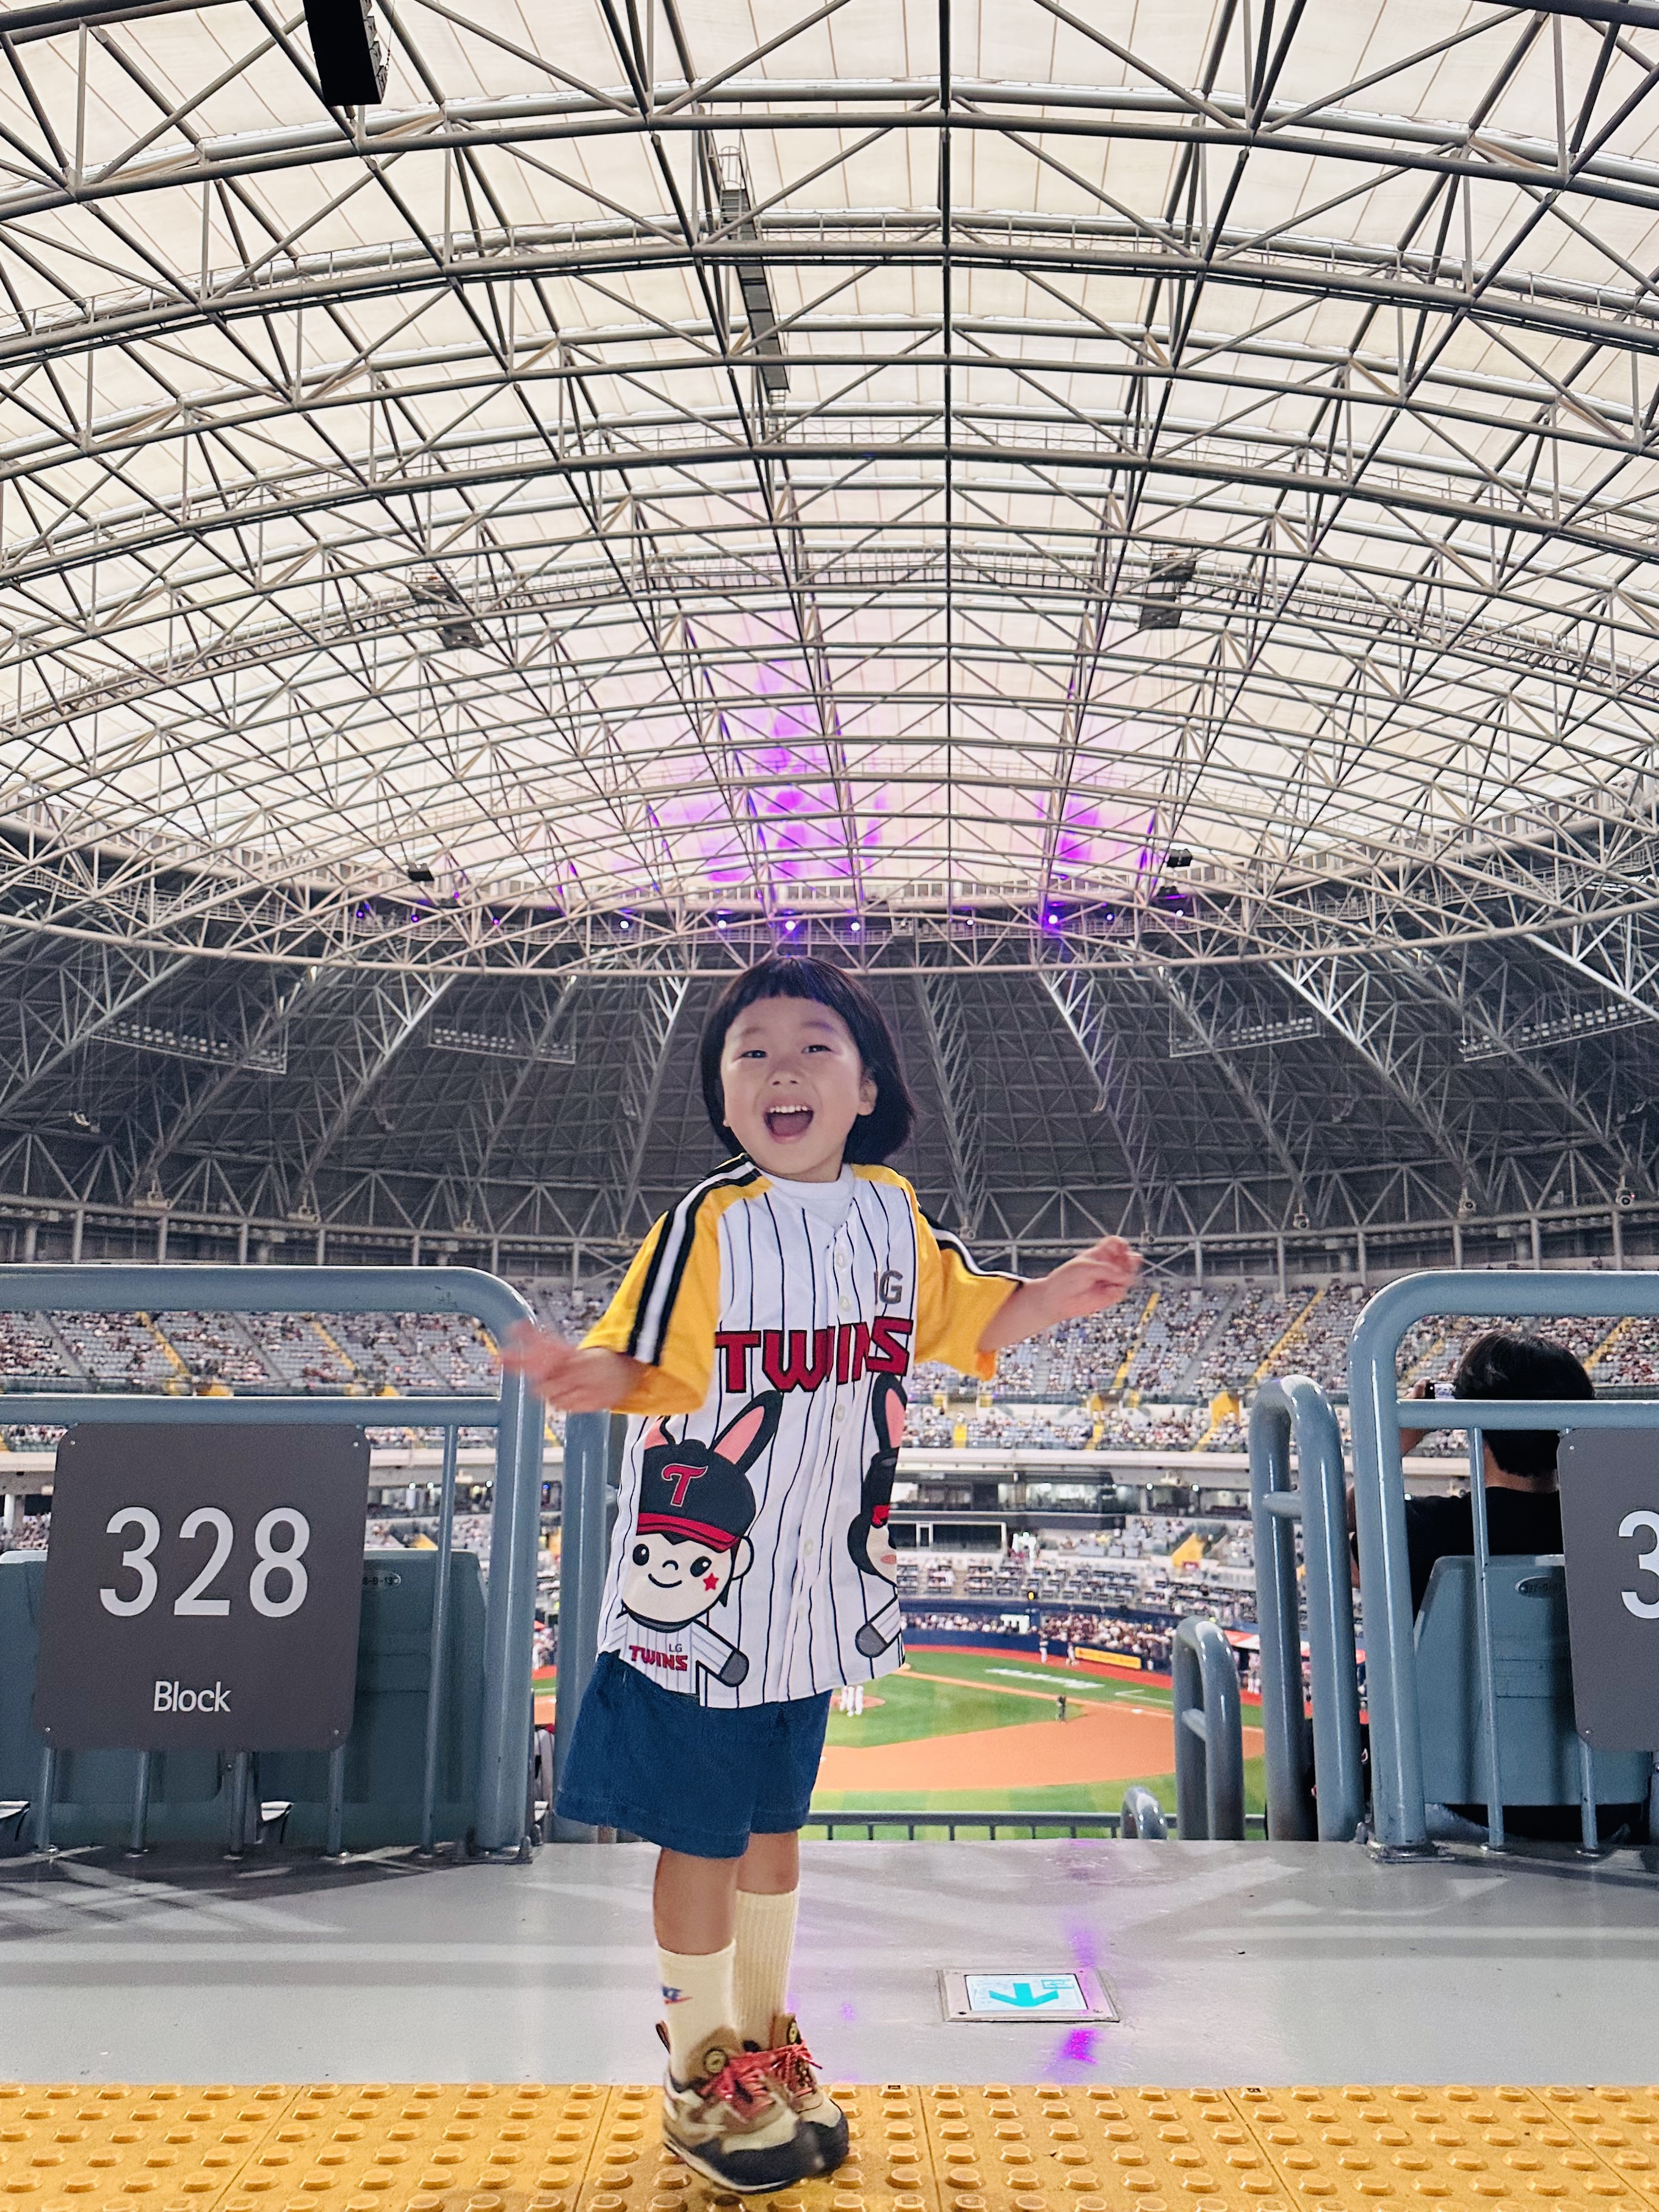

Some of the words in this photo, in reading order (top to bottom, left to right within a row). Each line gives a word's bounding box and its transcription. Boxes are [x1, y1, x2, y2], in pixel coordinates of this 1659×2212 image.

[873, 1270, 903, 1305] G
[661, 1462, 709, 1507] T
[99, 1506, 311, 1617] 328
[629, 1644, 689, 1672] TWINS
[669, 1643, 682, 1653] LG
[153, 1680, 231, 1712] Block
